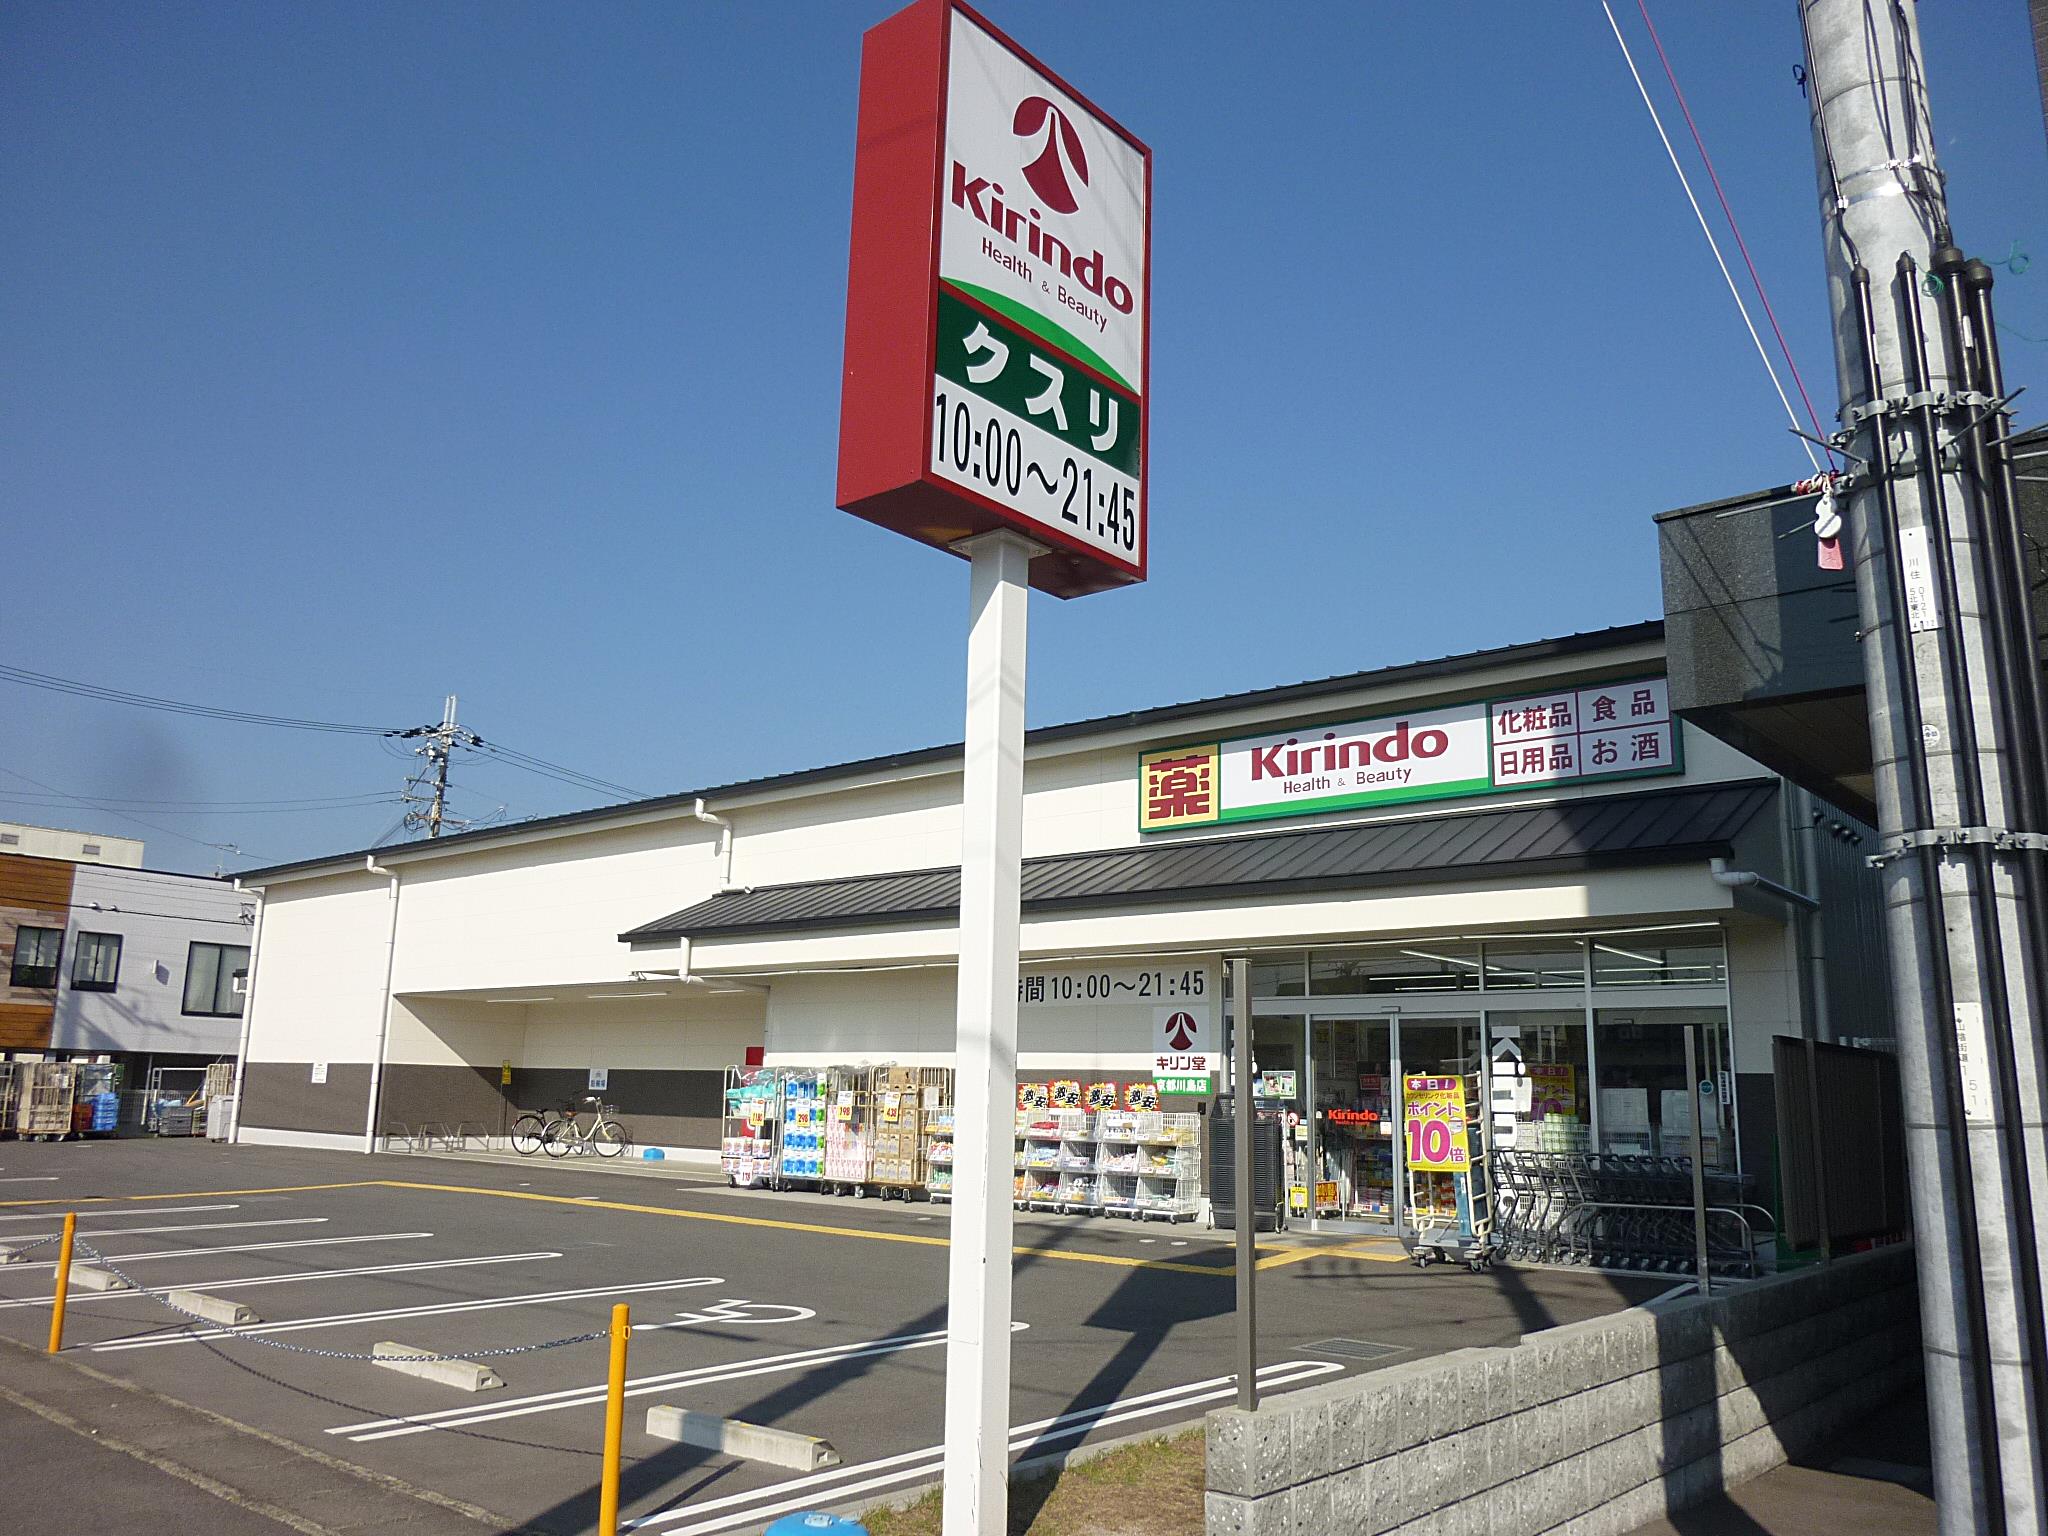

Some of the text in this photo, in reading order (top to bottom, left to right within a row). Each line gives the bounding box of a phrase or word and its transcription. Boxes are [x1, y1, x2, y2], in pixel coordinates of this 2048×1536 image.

[951, 161, 1134, 315] Kirindo
[981, 236, 1108, 333] Health & Beauty
[962, 321, 1119, 452] クスリ
[1497, 701, 1573, 736] 化粧品
[1591, 689, 1656, 723] 食品
[1251, 721, 1449, 781] Kirindo
[1499, 743, 1573, 776] 日用品
[1591, 734, 1660, 765] お酒
[1147, 757, 1210, 820] 薬
[1283, 765, 1412, 794] Health & Beauty
[1018, 975, 1045, 1003] 間
[1156, 1056, 1206, 1071] キリン堂
[1054, 1085, 1079, 1105] 激安
[1089, 1088, 1115, 1108] 激安
[1129, 1089, 1157, 1109] 激安
[1156, 1079, 1207, 1093] 京都川島店
[1328, 1109, 1378, 1121] Kirindo
[1408, 1101, 1461, 1116] ポイント
